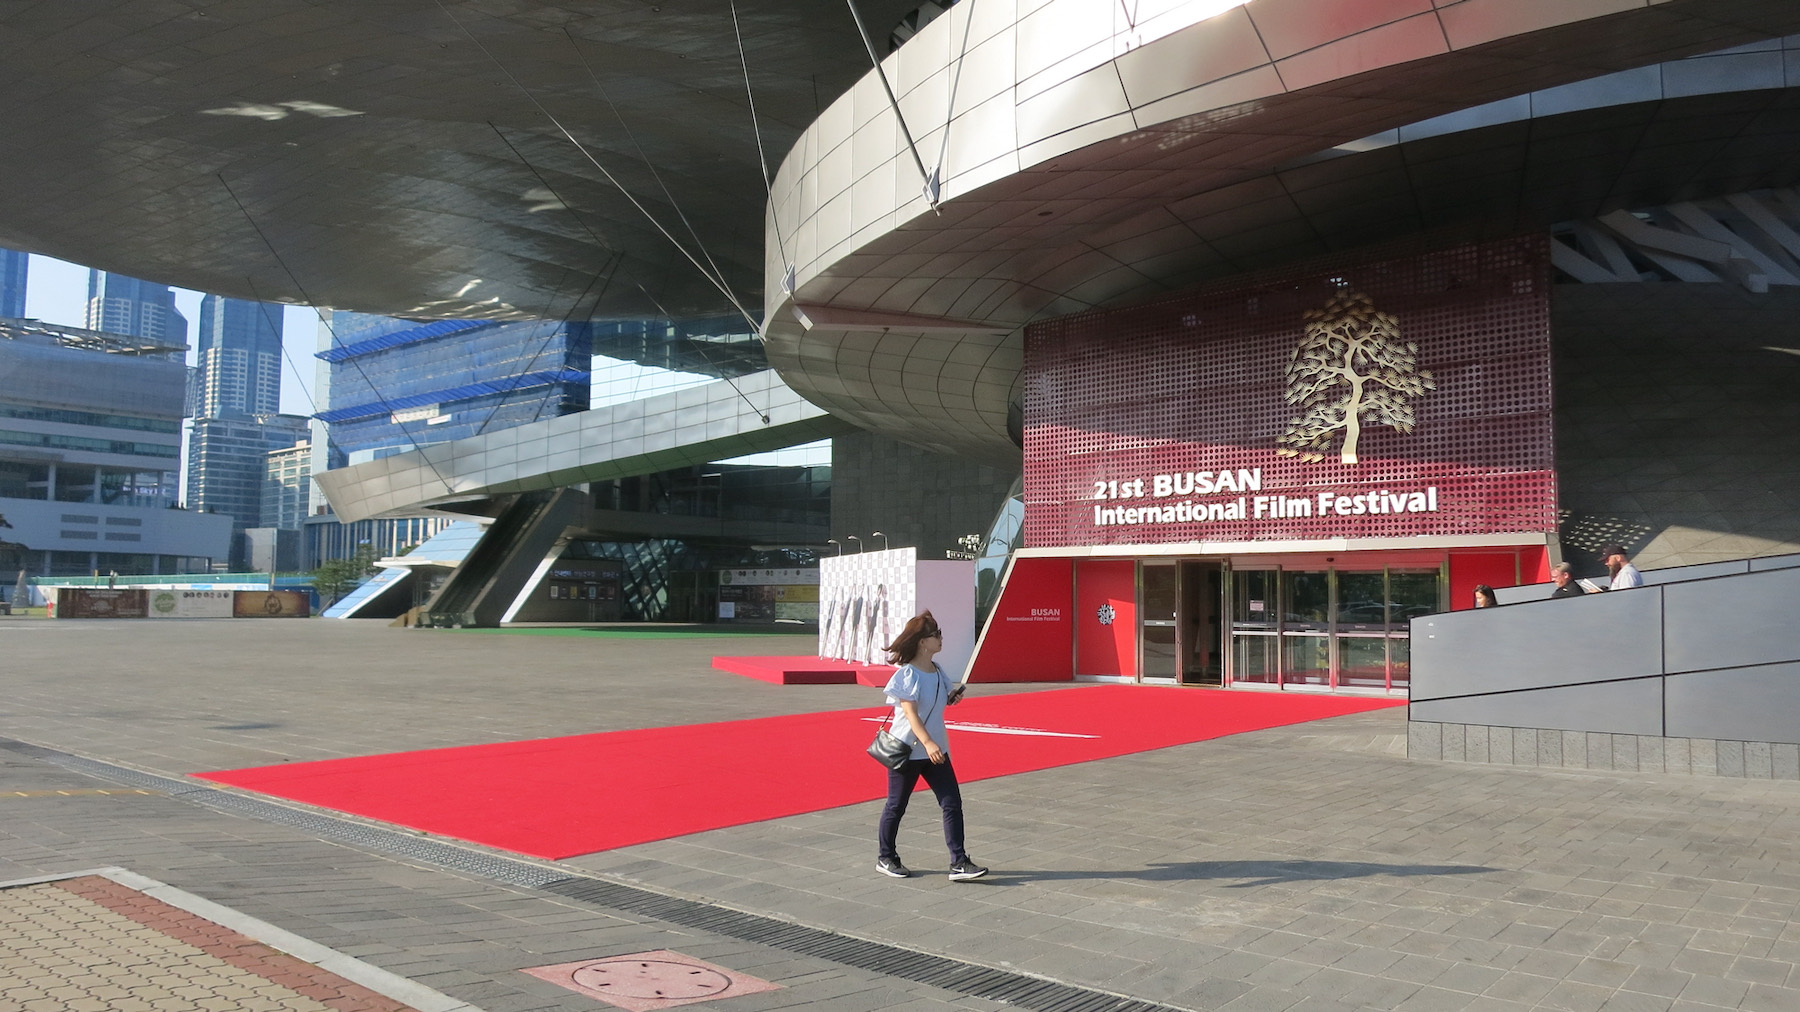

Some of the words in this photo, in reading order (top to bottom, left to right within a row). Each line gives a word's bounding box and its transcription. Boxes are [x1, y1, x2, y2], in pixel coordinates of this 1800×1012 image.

[1093, 478, 1145, 500] 21st
[1153, 467, 1262, 498] BUSAN
[1094, 497, 1246, 526] International
[1253, 495, 1312, 519] Film
[1318, 486, 1438, 516] Festival
[1030, 608, 1061, 616] BUSAN
